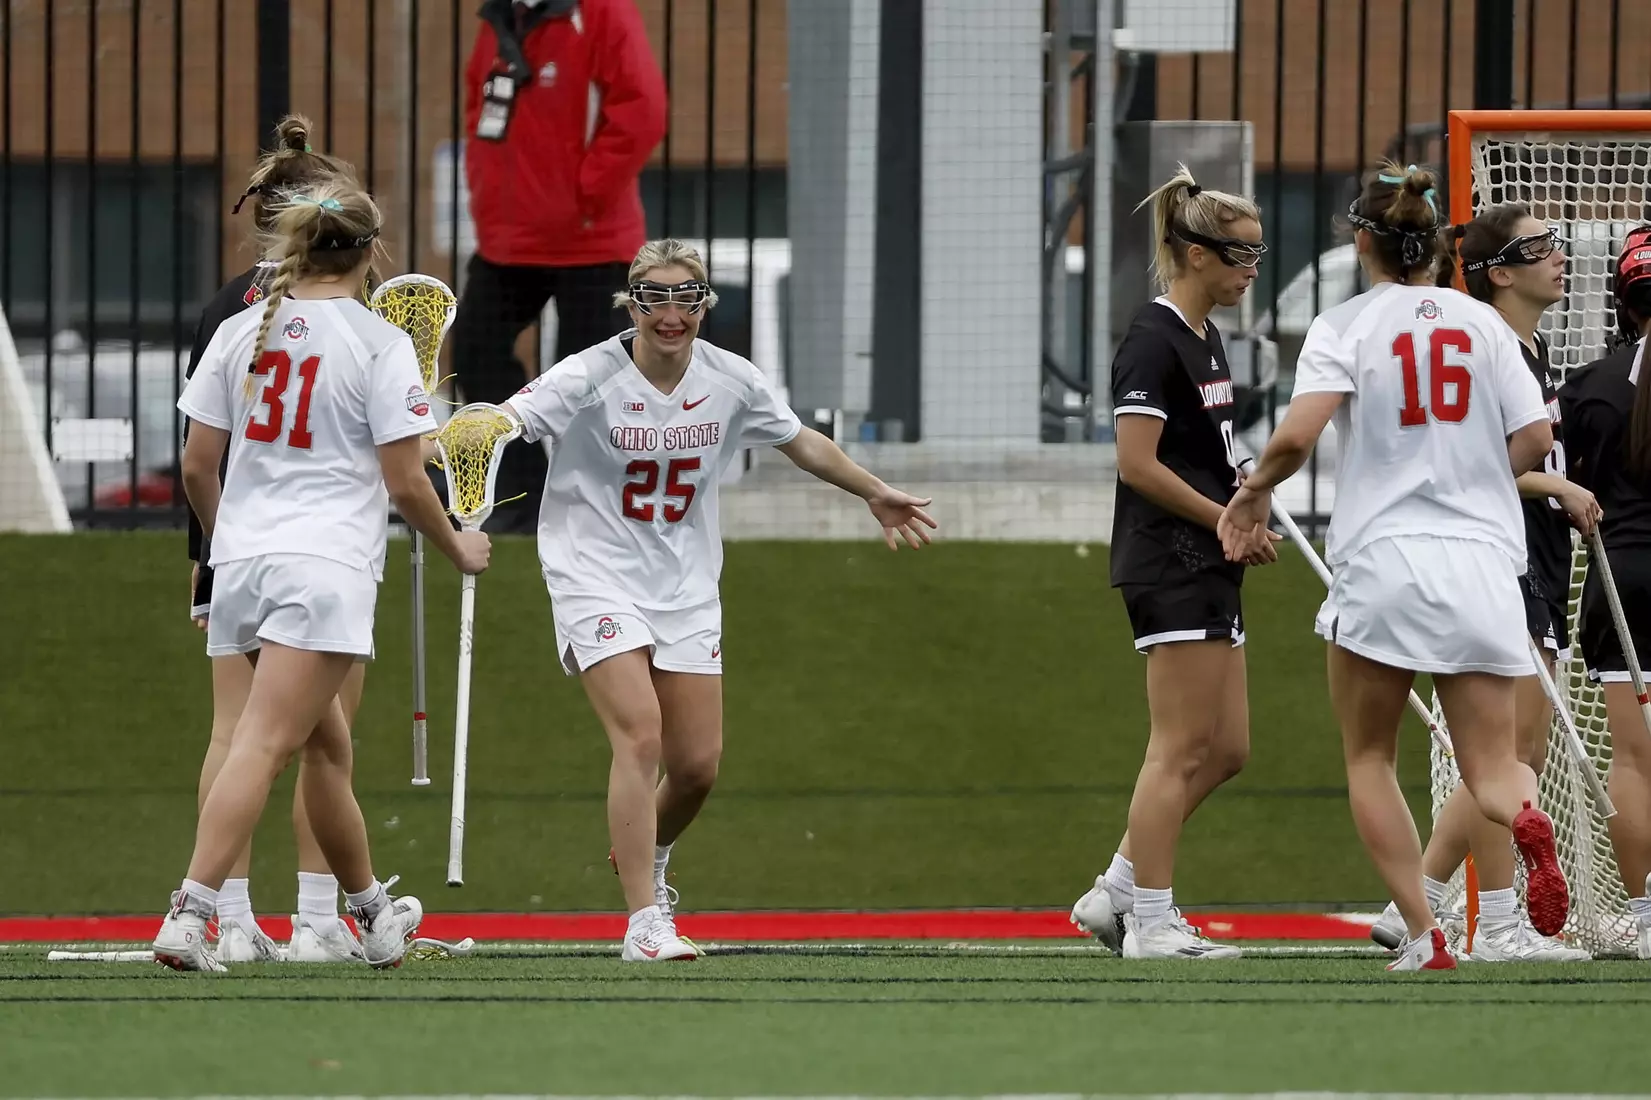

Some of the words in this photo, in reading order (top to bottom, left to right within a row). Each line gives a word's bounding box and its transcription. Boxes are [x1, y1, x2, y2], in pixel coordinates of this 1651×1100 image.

[1467, 261, 1484, 271] GAIT
[1486, 255, 1506, 266] GAIT
[244, 348, 323, 452] 31
[1122, 390, 1149, 401] ACC
[1390, 327, 1473, 429] 16
[610, 426, 658, 451] OHIO
[663, 422, 720, 450] STATE
[621, 456, 702, 524] 25
